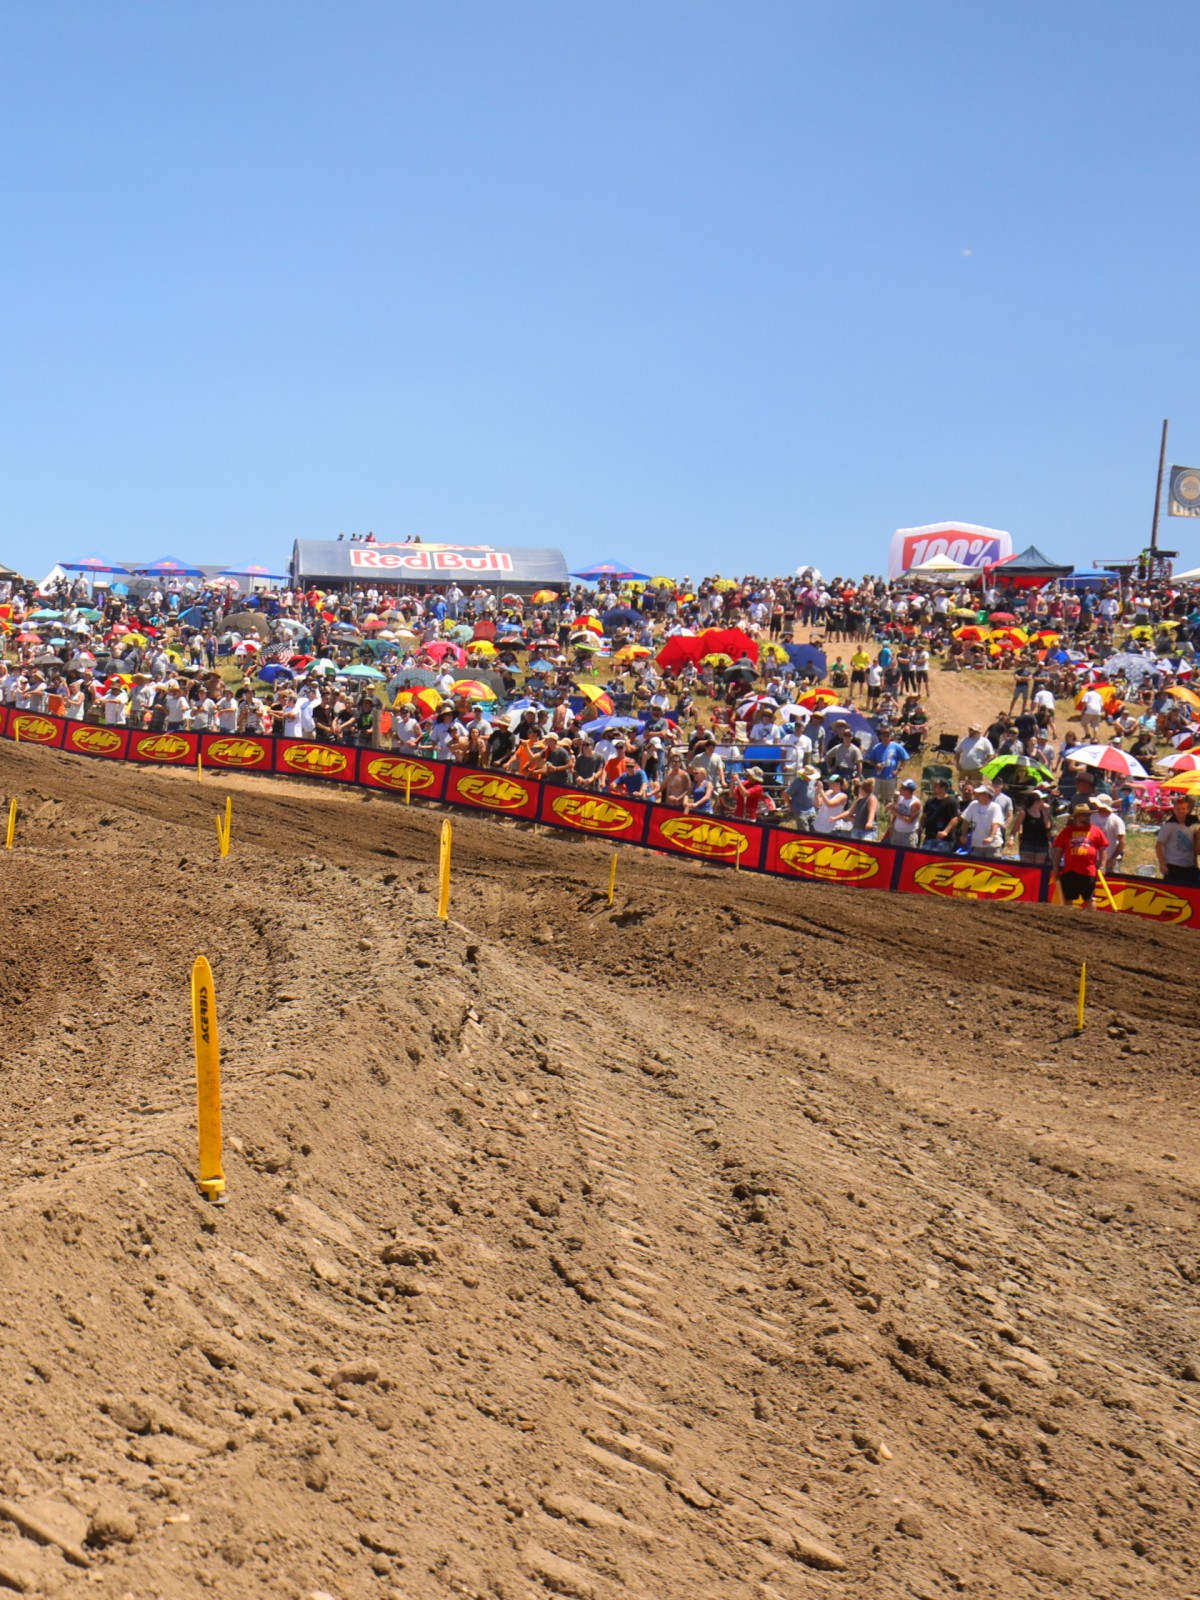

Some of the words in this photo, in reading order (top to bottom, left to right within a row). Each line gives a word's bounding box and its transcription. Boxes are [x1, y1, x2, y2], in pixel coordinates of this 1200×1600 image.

[350, 549, 431, 570] Red
[434, 551, 513, 571] Bull
[912, 538, 993, 567] 100%
[14, 718, 57, 735] FMF
[72, 728, 121, 746] FMF
[137, 736, 189, 753] FMF
[208, 740, 264, 757] FMF
[284, 745, 347, 767] FMF
[368, 759, 434, 782] FMF
[457, 775, 528, 801] FMF
[552, 795, 630, 823] FMF
[581, 819, 599, 827] RACING
[661, 818, 745, 849] FMF
[692, 842, 713, 851] RACING
[780, 841, 878, 873] FMF
[814, 867, 837, 876] RACING
[914, 865, 1021, 892] FMF
[200, 986, 210, 1044] ACERBIS
